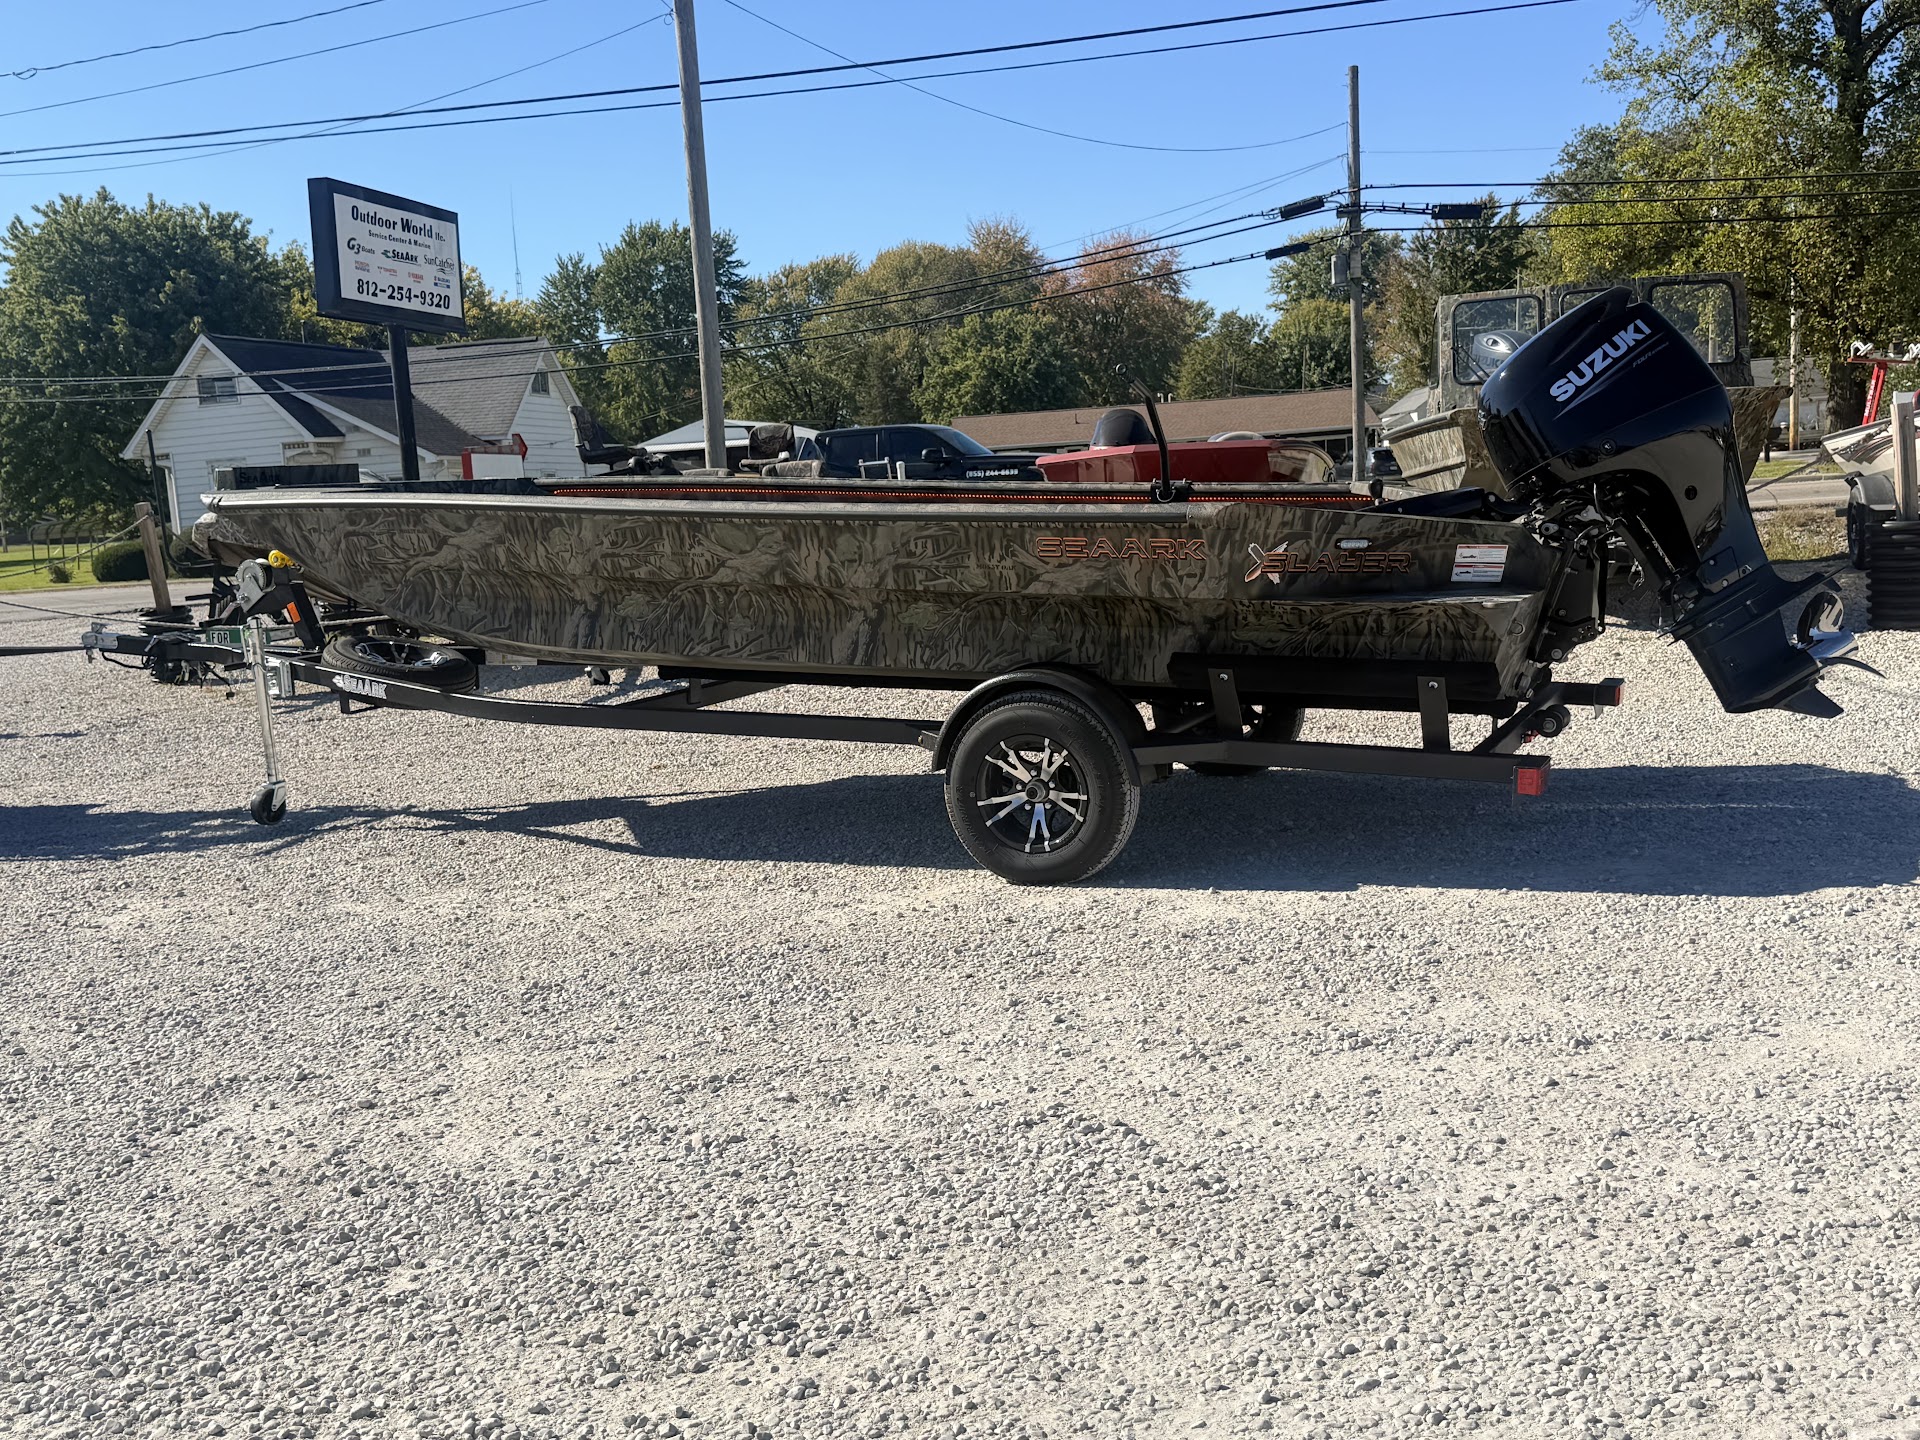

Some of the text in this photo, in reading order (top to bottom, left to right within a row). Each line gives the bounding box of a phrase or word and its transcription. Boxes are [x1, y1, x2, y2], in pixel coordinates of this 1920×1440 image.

[351, 205, 398, 231] Outdoor
[400, 217, 433, 239] World
[346, 237, 376, 255] G3 Boats
[368, 229, 388, 241] Service
[388, 234, 407, 245] Center
[408, 238, 412, 246] &
[423, 254, 455, 271] SunCatcher
[357, 278, 451, 310] 812-254-9320
[1549, 318, 1652, 402] SUZUKI
[1036, 536, 1207, 560] SEAARK
[211, 632, 229, 644] FOR
